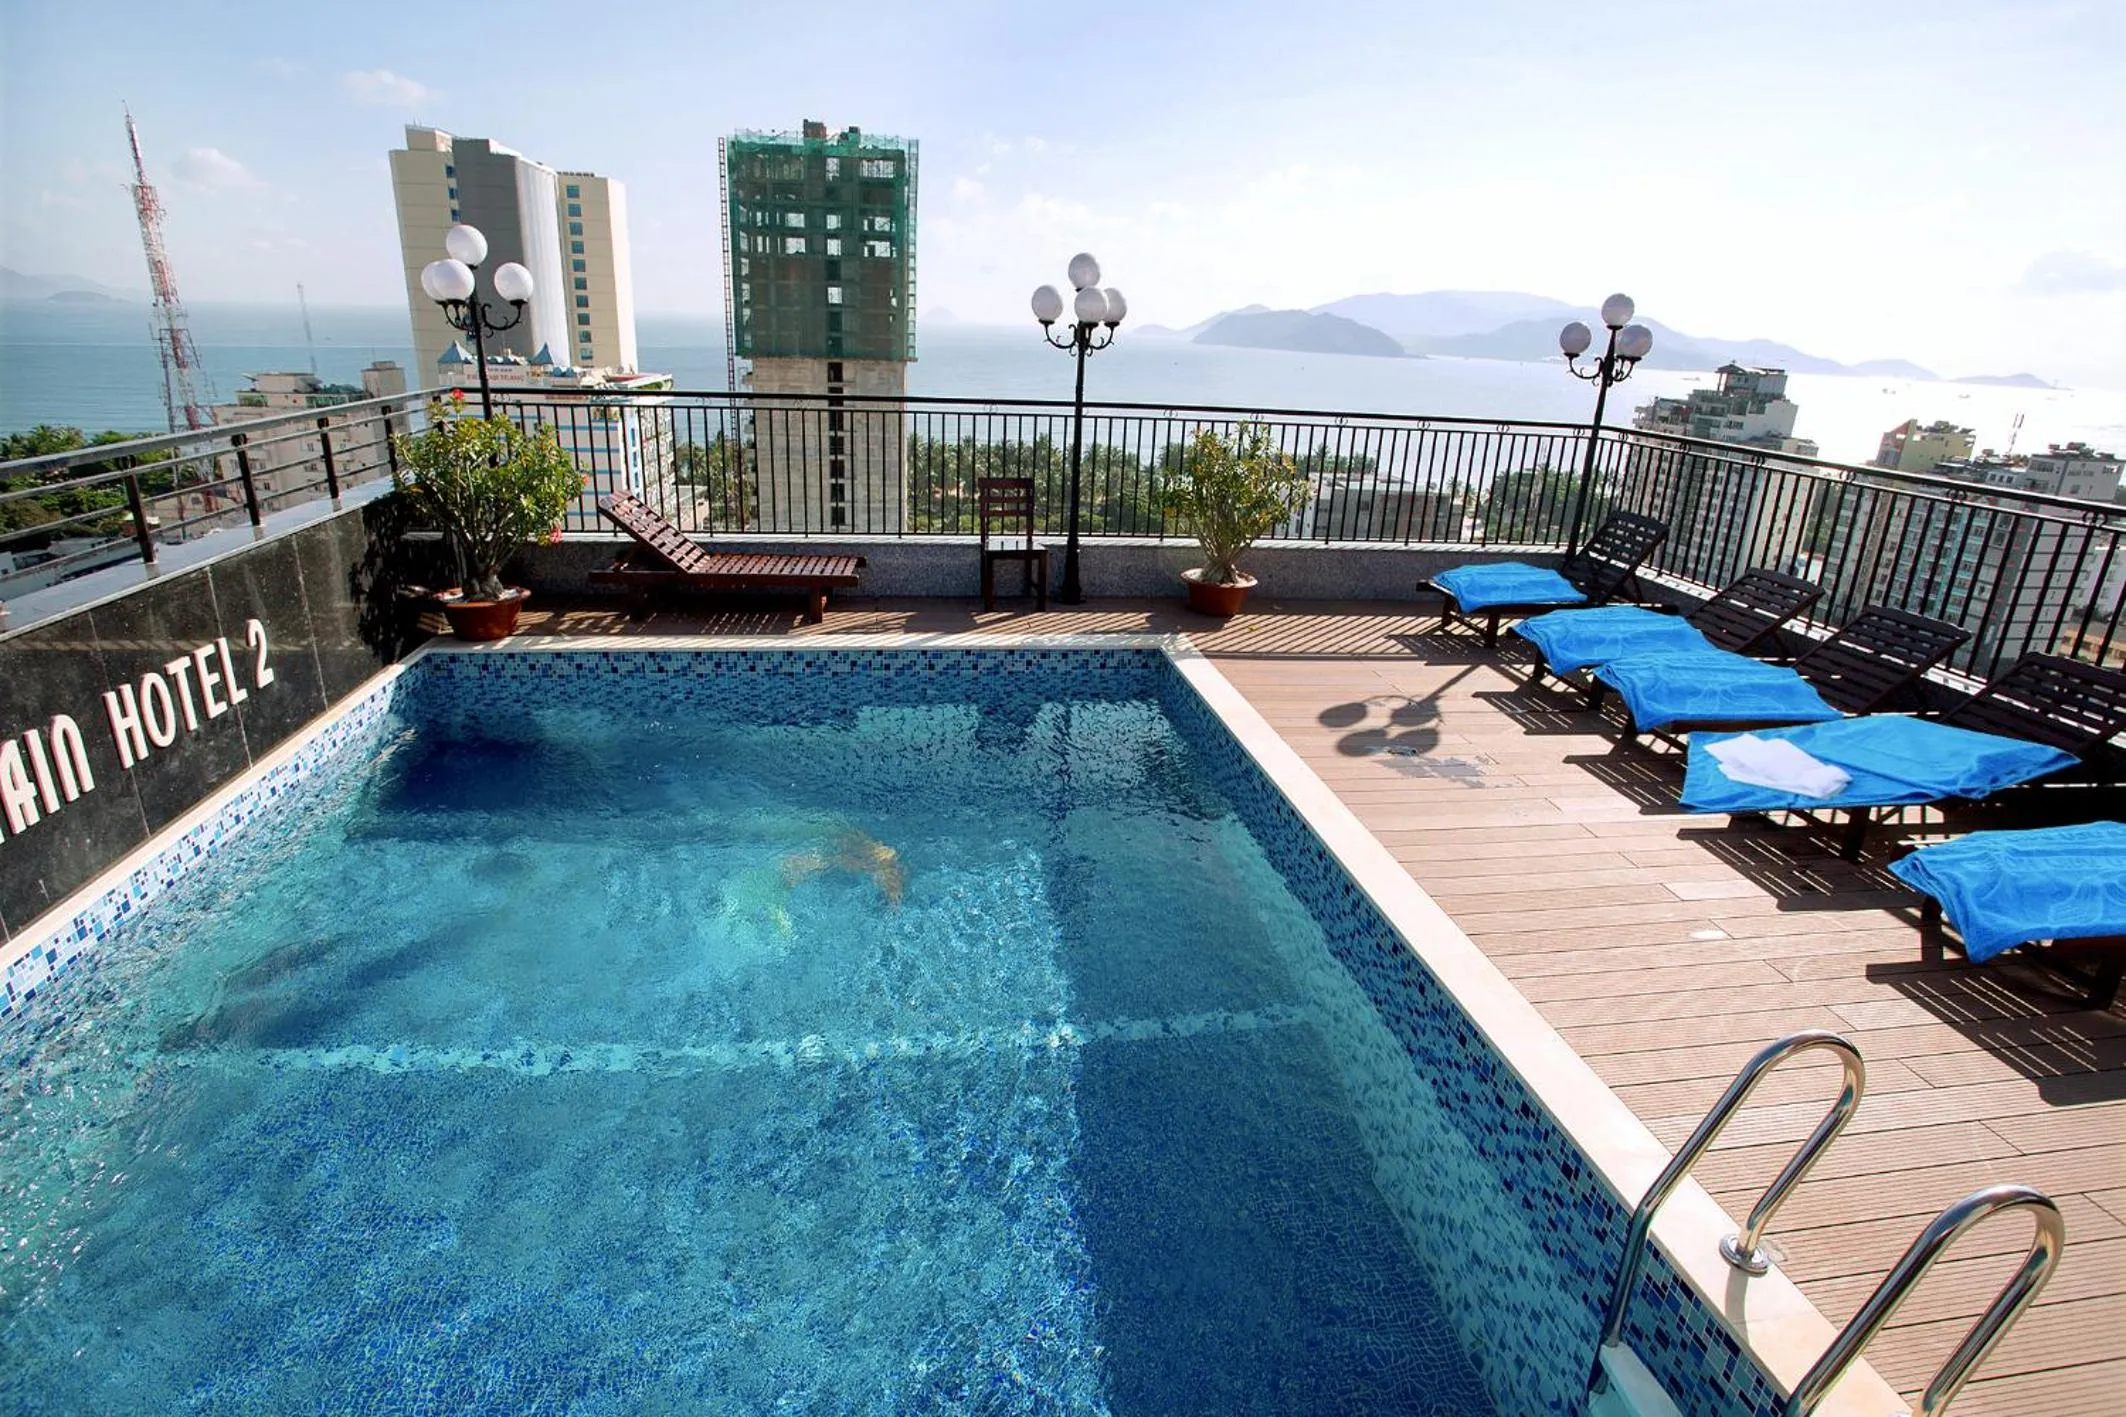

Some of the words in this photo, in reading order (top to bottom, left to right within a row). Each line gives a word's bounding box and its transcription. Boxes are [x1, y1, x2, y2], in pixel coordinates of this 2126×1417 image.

[0, 714, 95, 844] AIN
[103, 637, 248, 769] HOTEL
[246, 618, 275, 689] 2
